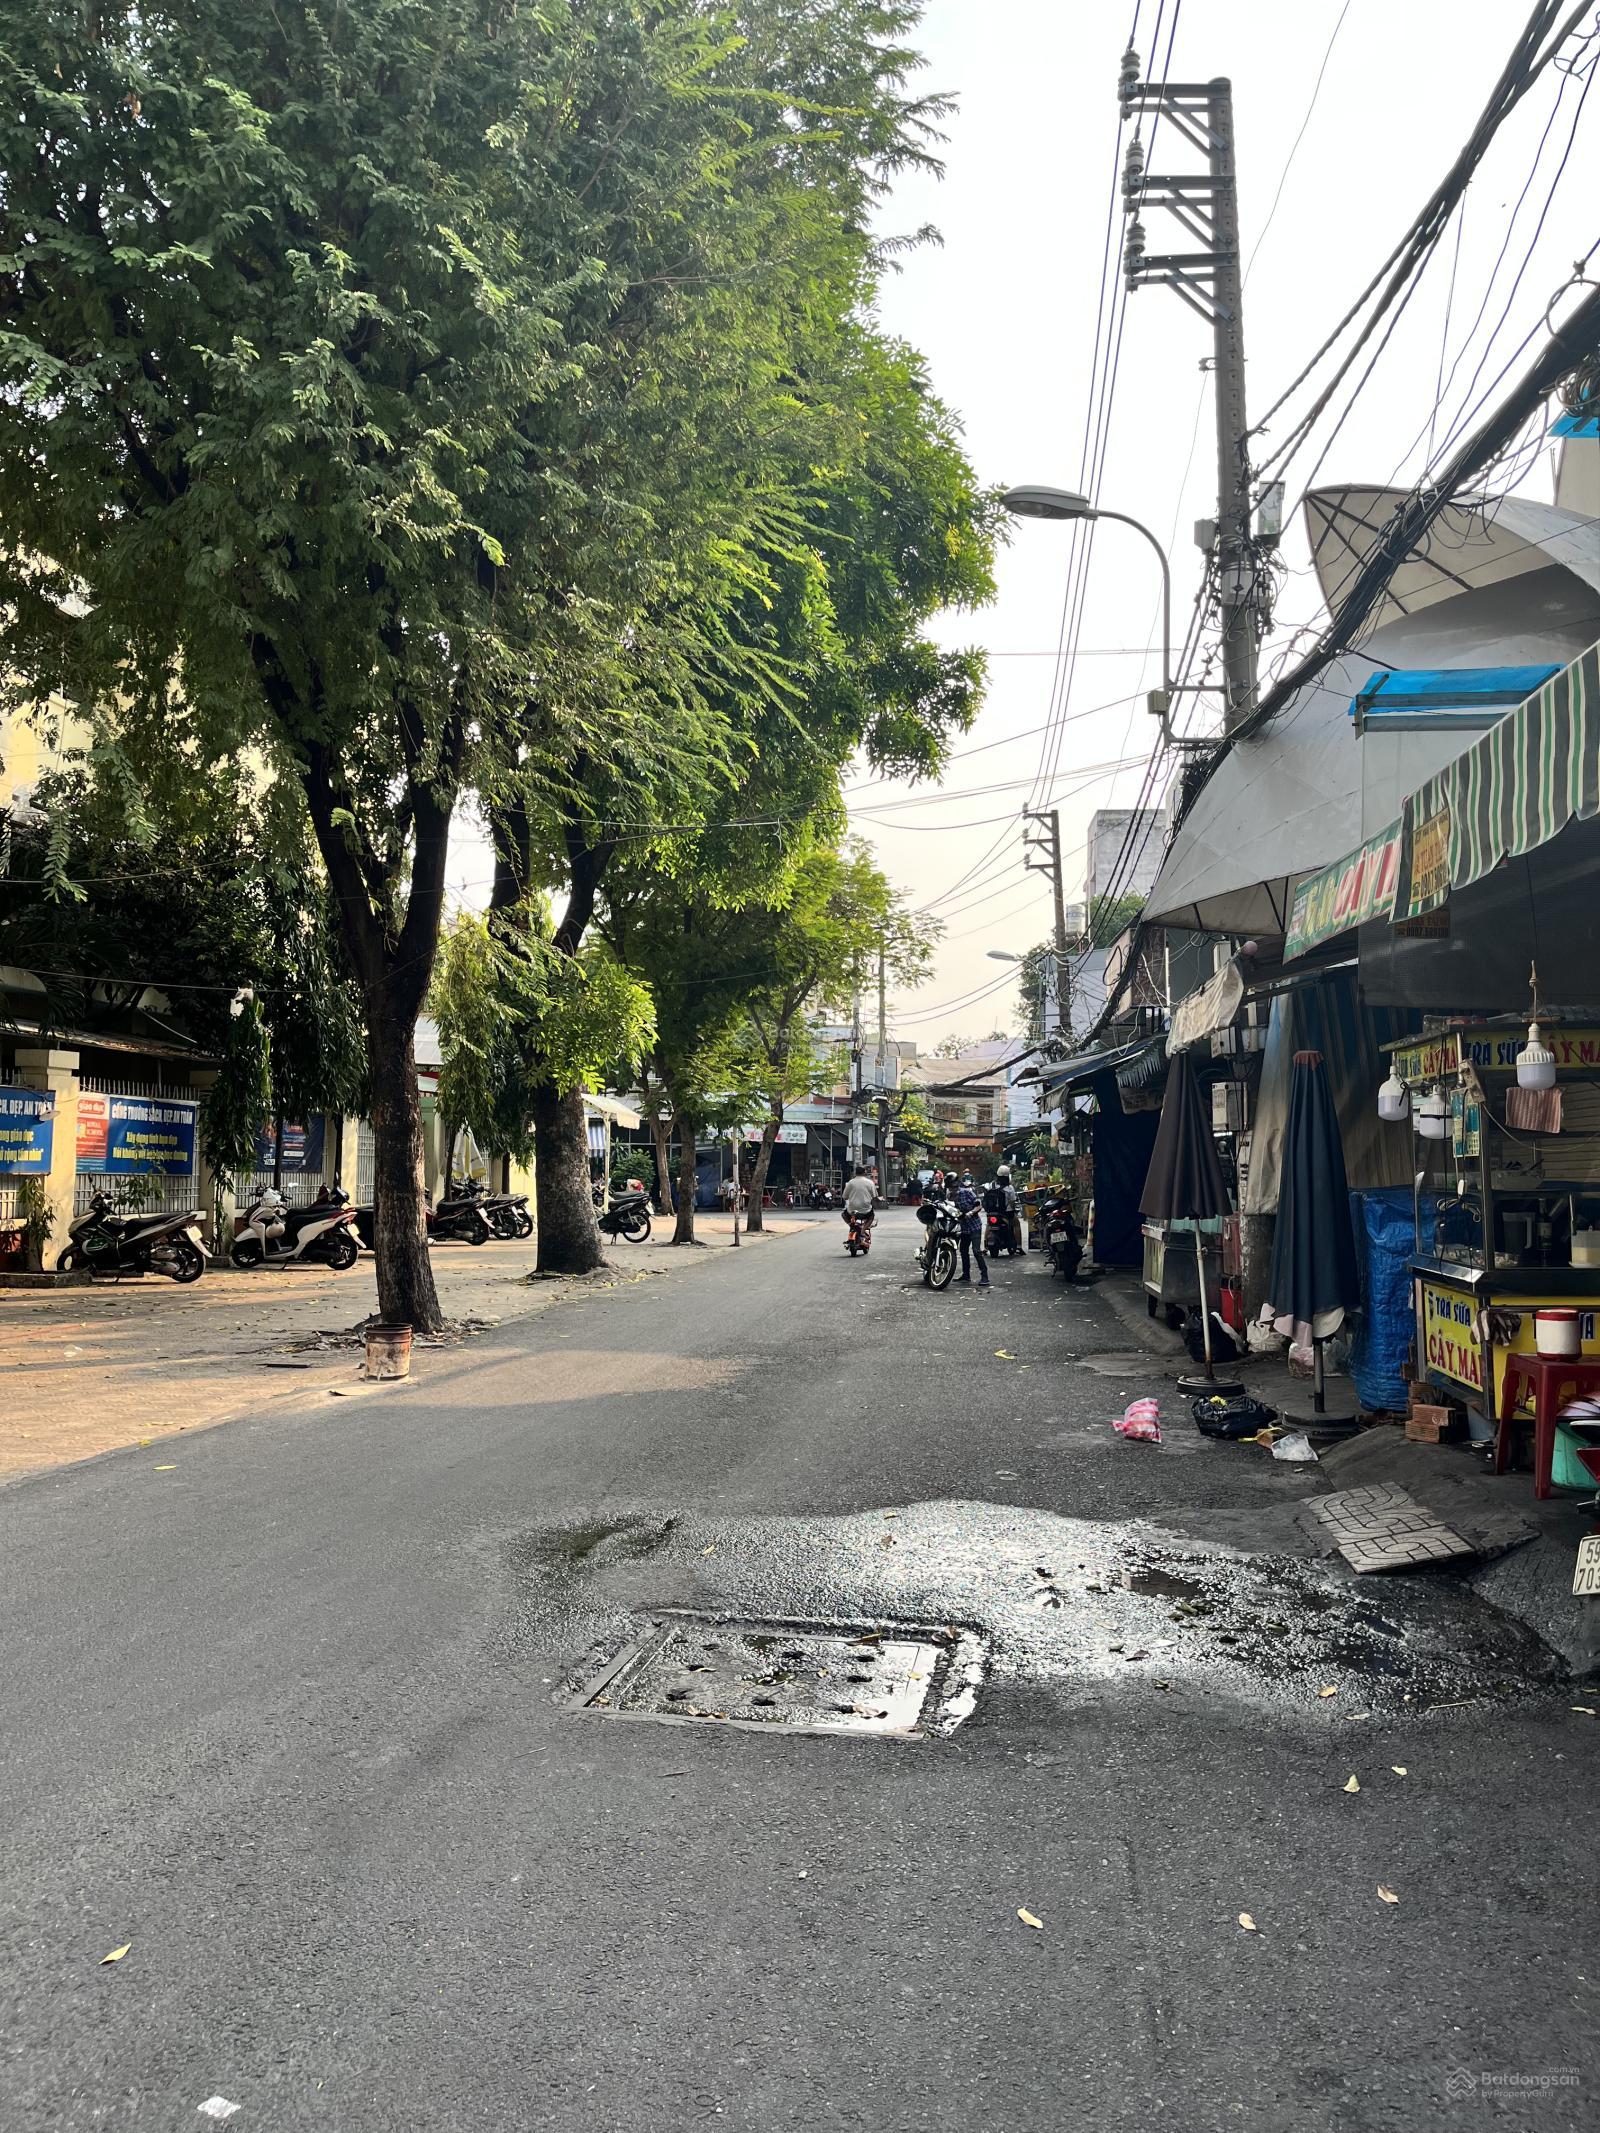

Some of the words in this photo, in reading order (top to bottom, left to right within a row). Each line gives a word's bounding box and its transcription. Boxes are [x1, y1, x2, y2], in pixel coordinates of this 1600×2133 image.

[24, 1101, 33, 1115] AN
[1435, 1295, 1451, 1320] TRÀ
[1429, 1328, 1454, 1373] CÂY
